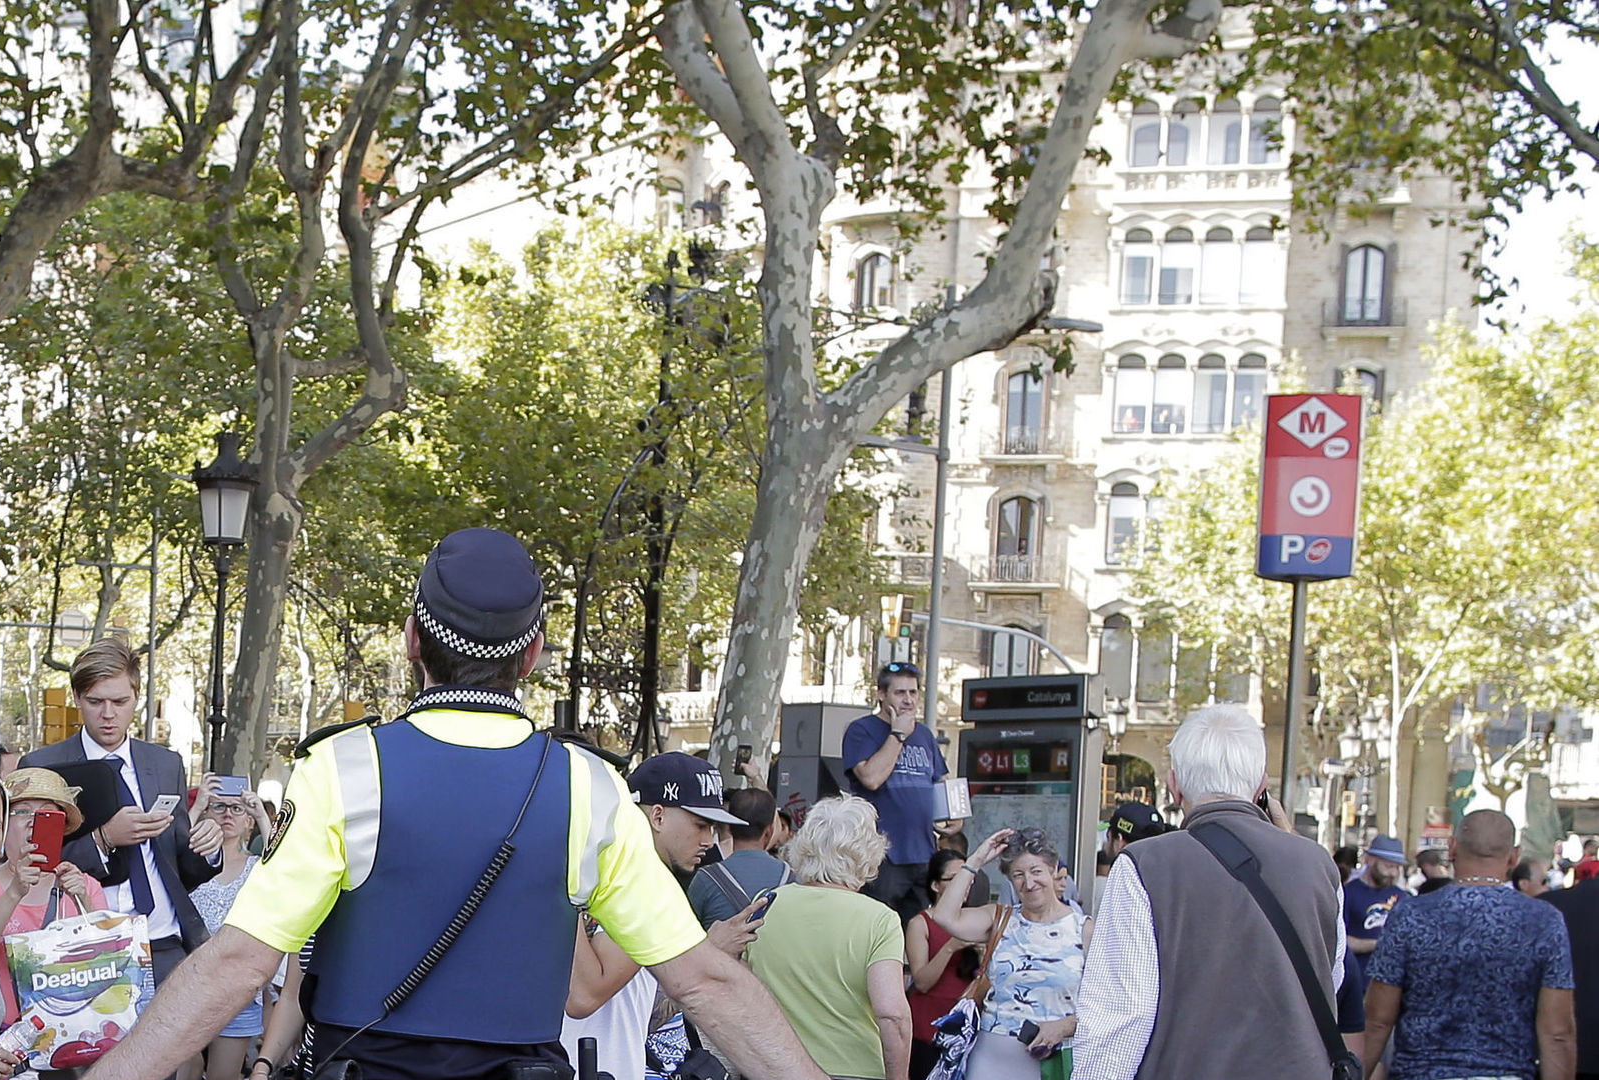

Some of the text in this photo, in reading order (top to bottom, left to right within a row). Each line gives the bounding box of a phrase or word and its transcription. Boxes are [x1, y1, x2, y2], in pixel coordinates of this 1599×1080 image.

[1299, 412, 1326, 434] M
[1280, 535, 1305, 564] P
[1027, 691, 1072, 705] Catalunya
[996, 750, 1068, 769] L1 L3 R
